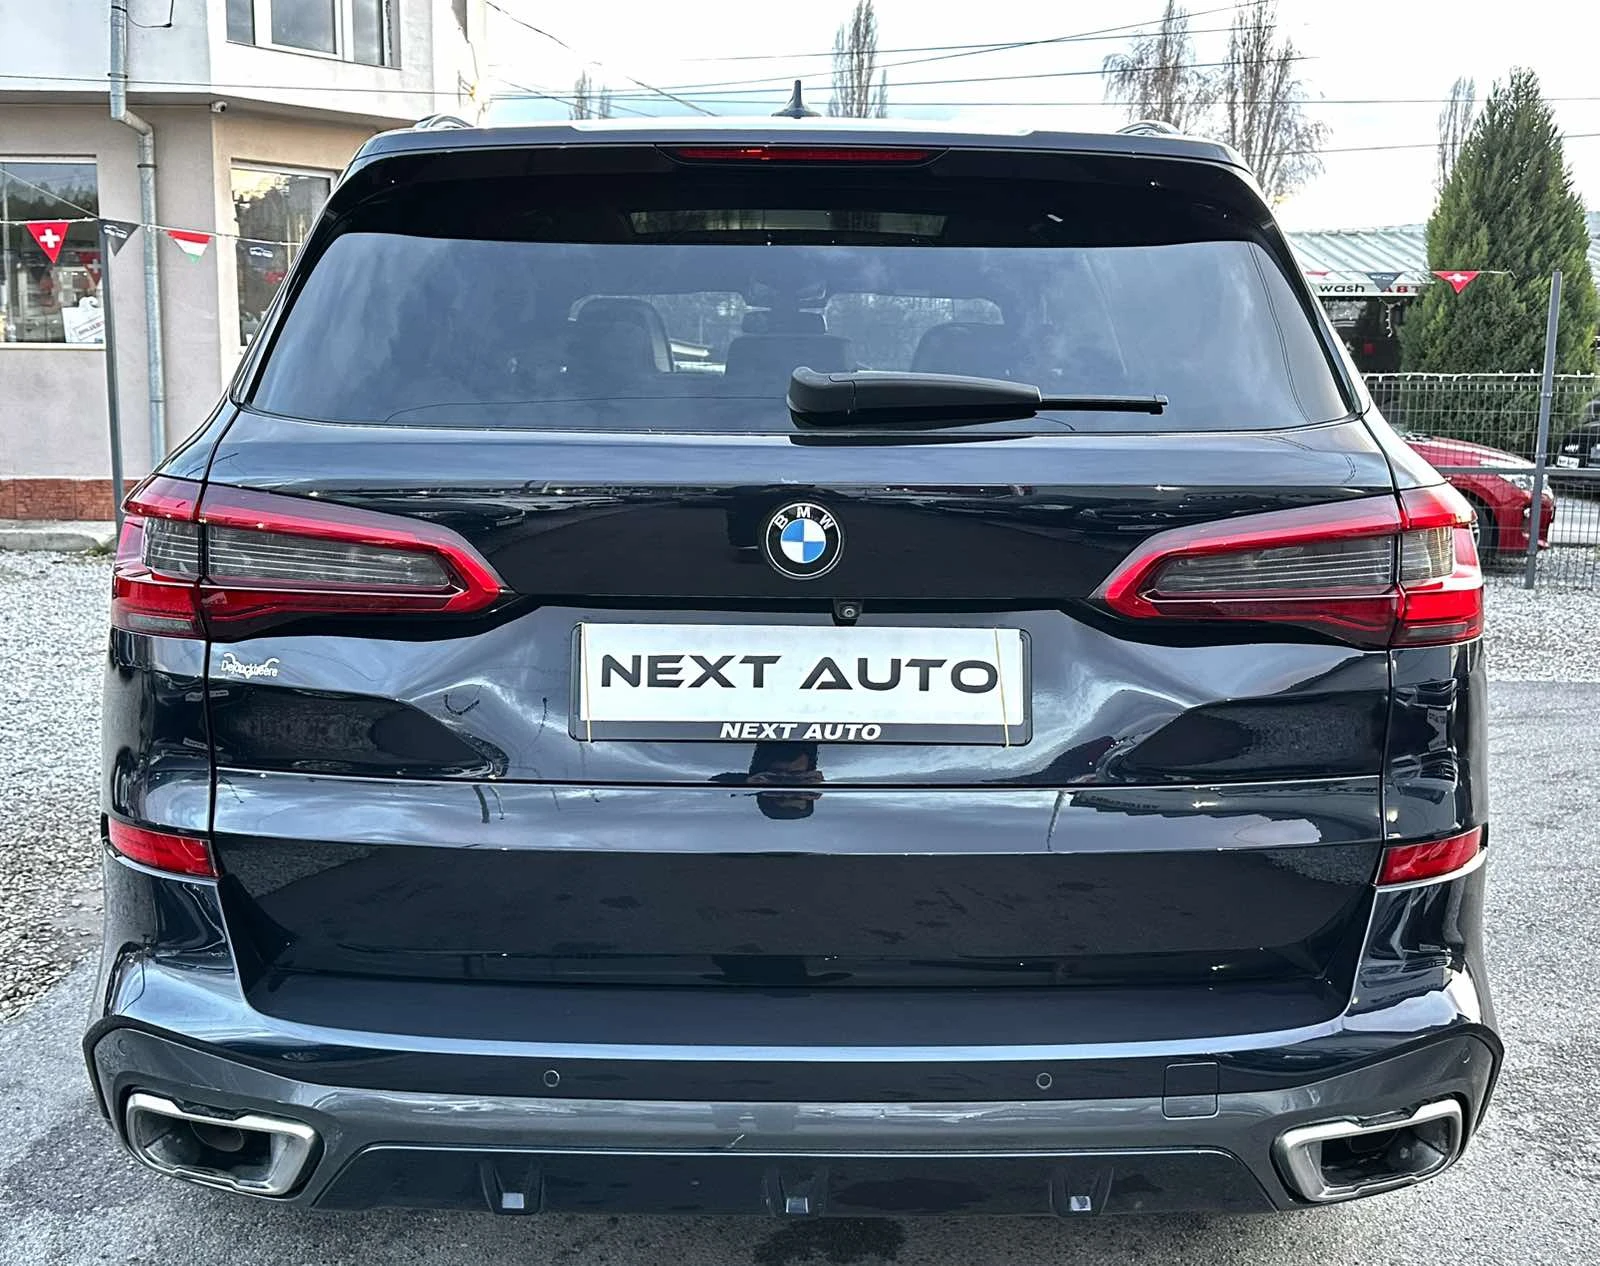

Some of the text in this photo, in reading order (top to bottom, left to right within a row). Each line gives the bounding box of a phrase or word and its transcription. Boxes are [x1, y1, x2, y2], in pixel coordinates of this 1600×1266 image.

[1319, 283, 1365, 293] wash
[773, 506, 835, 530] BMW
[601, 654, 998, 694] NEXT AUTO
[720, 722, 882, 740] NEXT AUTO
